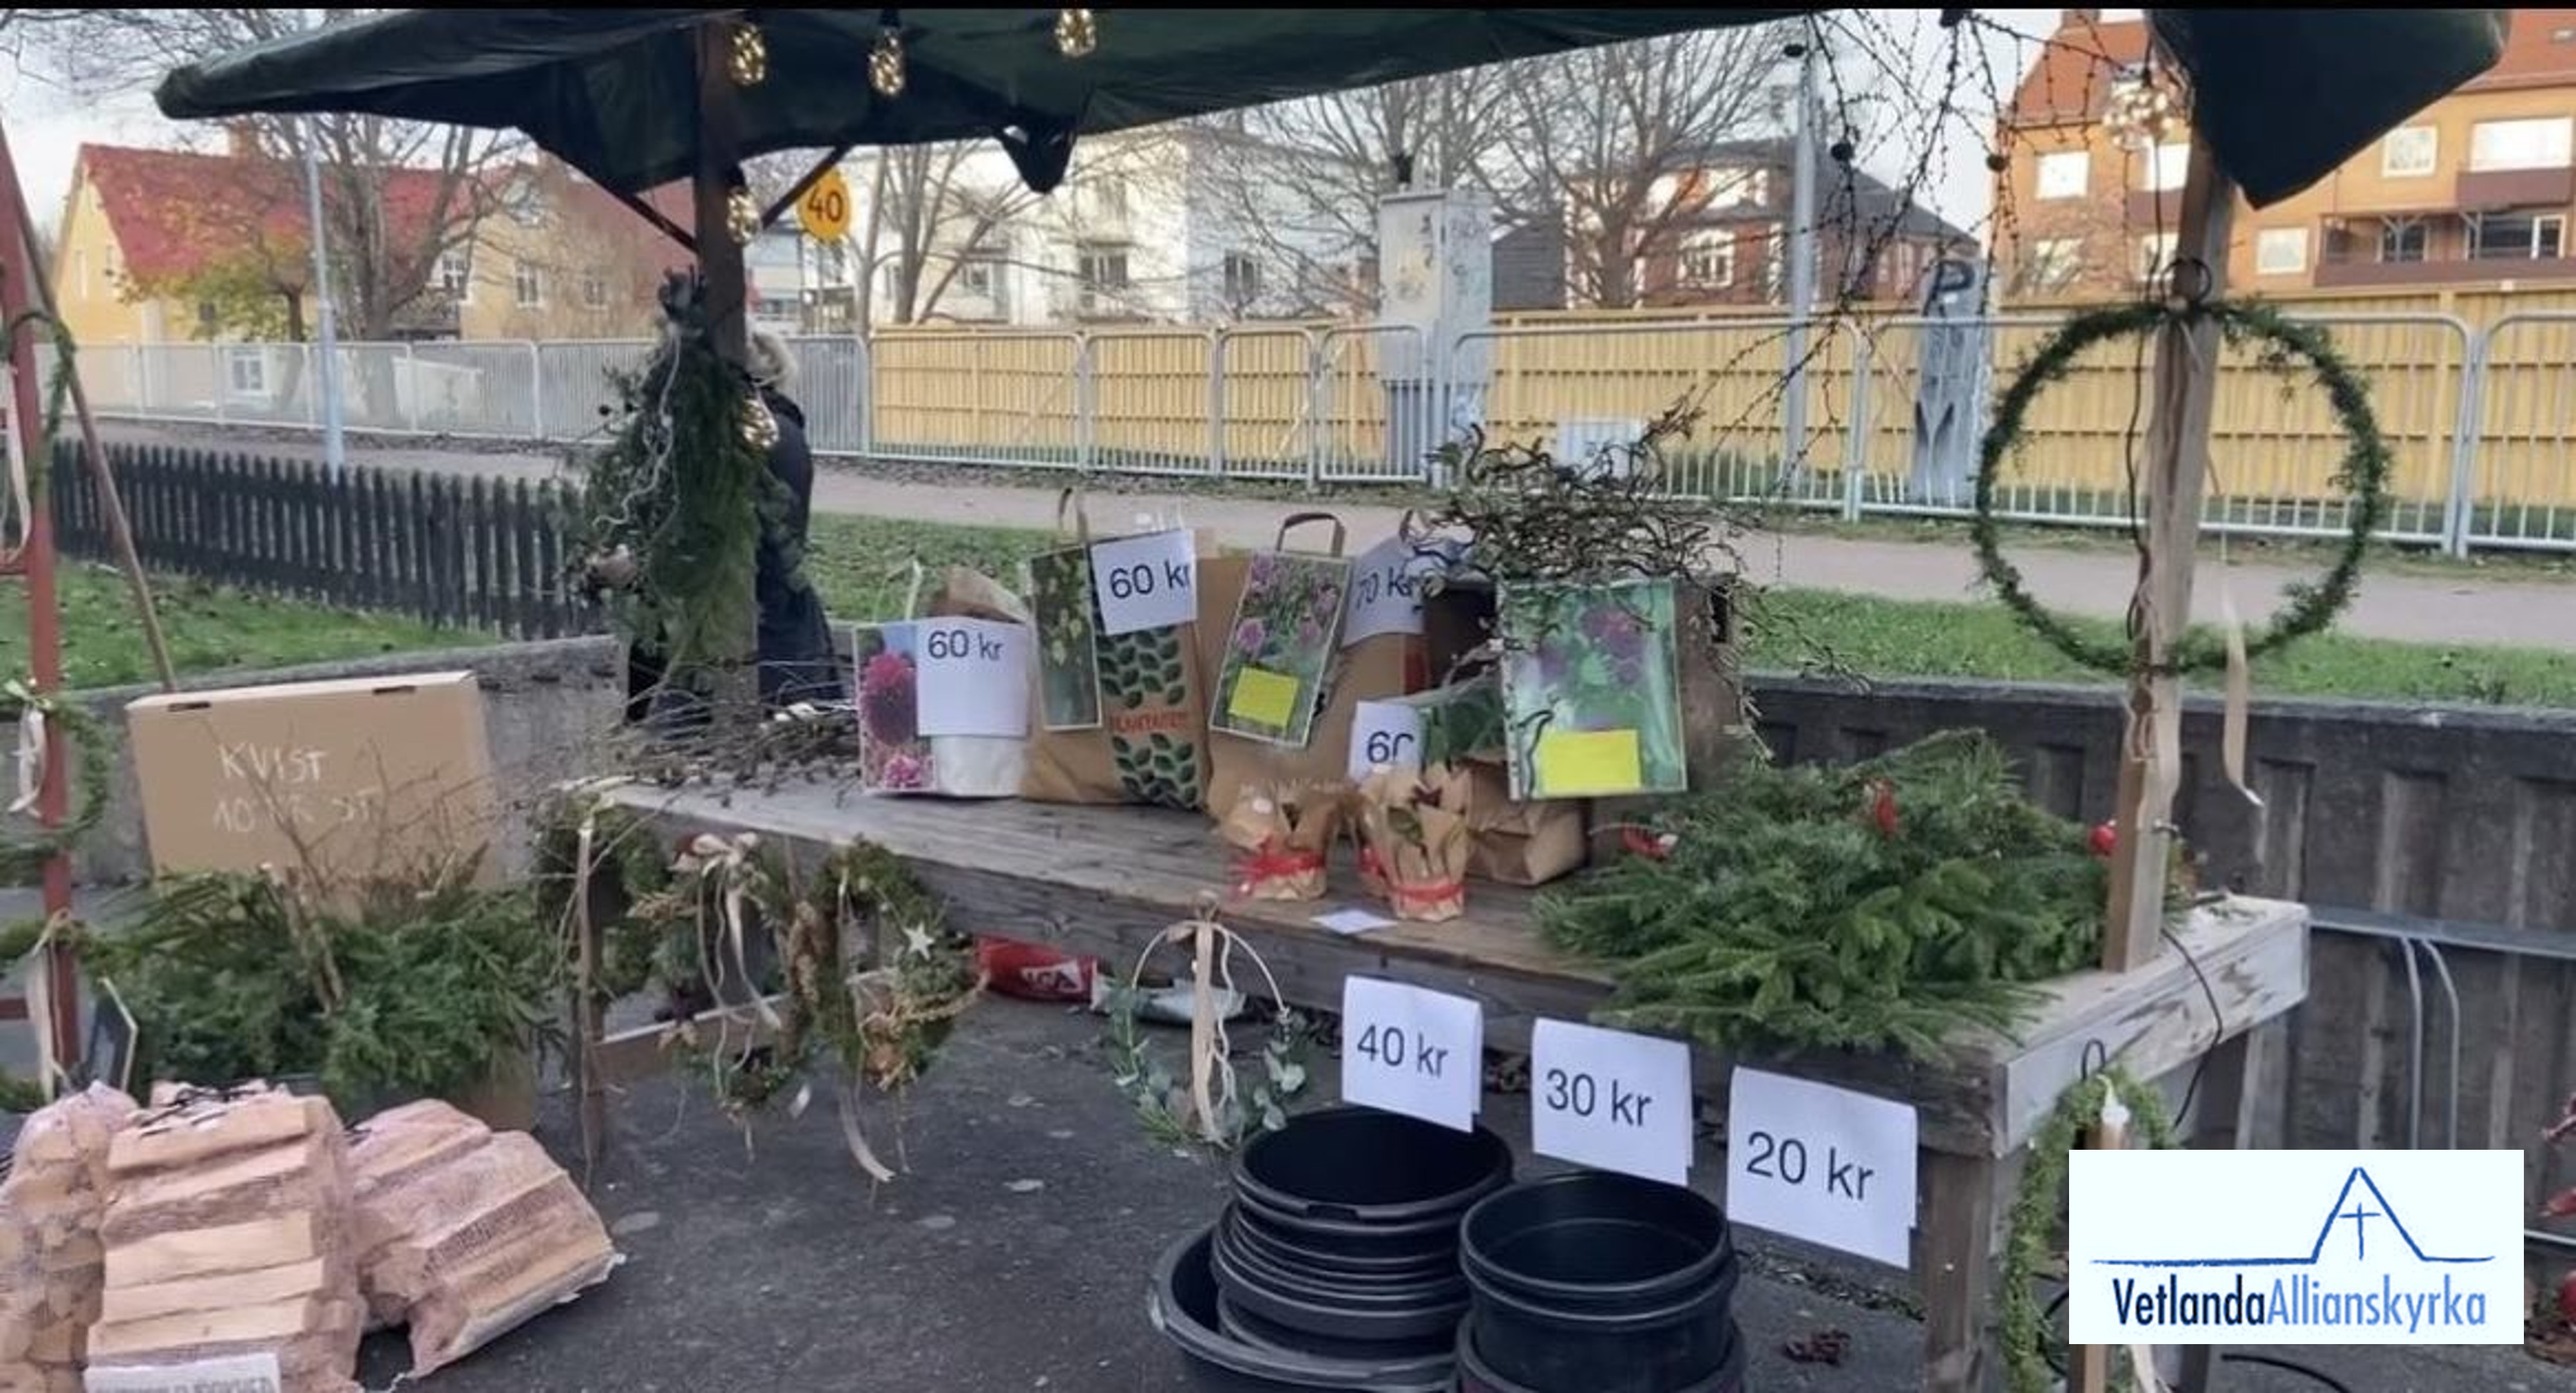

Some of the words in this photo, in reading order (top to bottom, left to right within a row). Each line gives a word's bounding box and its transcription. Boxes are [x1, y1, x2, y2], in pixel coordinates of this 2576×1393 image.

[807, 190, 843, 223] 40
[1109, 564, 1154, 599] 60
[928, 629, 970, 660] 60
[978, 632, 1004, 661] kr
[219, 742, 327, 783] KVIST
[213, 797, 255, 832] 10
[1357, 1024, 1404, 1067] 40
[1417, 1033, 1448, 1077] kr
[1547, 1069, 1596, 1117] 30
[1612, 1079, 1652, 1127] kr
[1746, 1131, 1807, 1185] 20
[1828, 1148, 1874, 1200] kr
